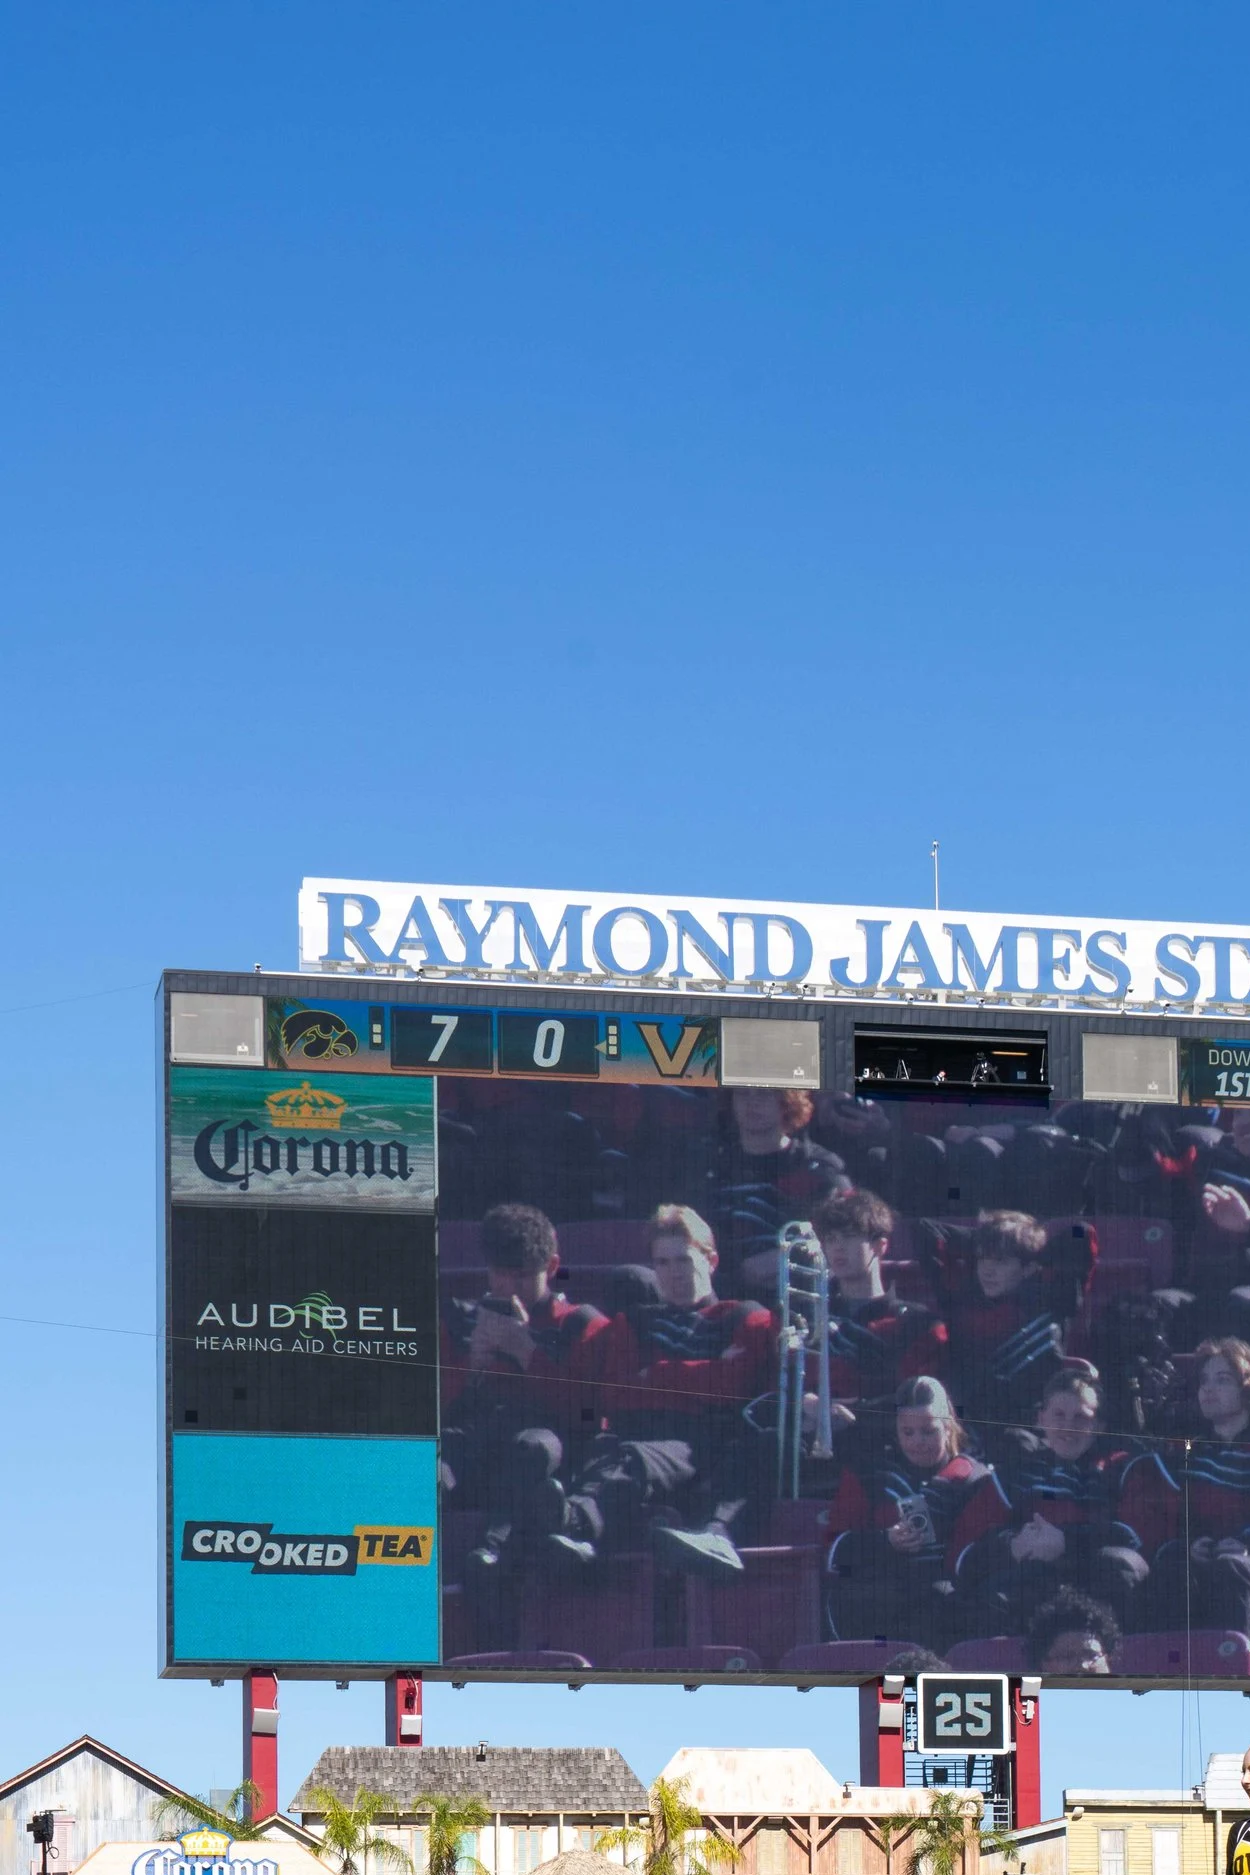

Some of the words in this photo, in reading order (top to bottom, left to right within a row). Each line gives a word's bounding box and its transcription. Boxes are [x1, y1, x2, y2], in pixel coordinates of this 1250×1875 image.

[317, 891, 813, 984] RAYMOND
[829, 918, 1131, 995] JAMES
[427, 1015, 459, 1062] 7
[533, 1019, 566, 1068] 0
[193, 1118, 415, 1191] Corona
[196, 1302, 417, 1332] AUDIBEL
[195, 1336, 283, 1352] HEARING
[291, 1338, 325, 1354] AID
[332, 1340, 418, 1356] CENTERS
[191, 1528, 349, 1568] CROOKED
[935, 1691, 992, 1738] 25
